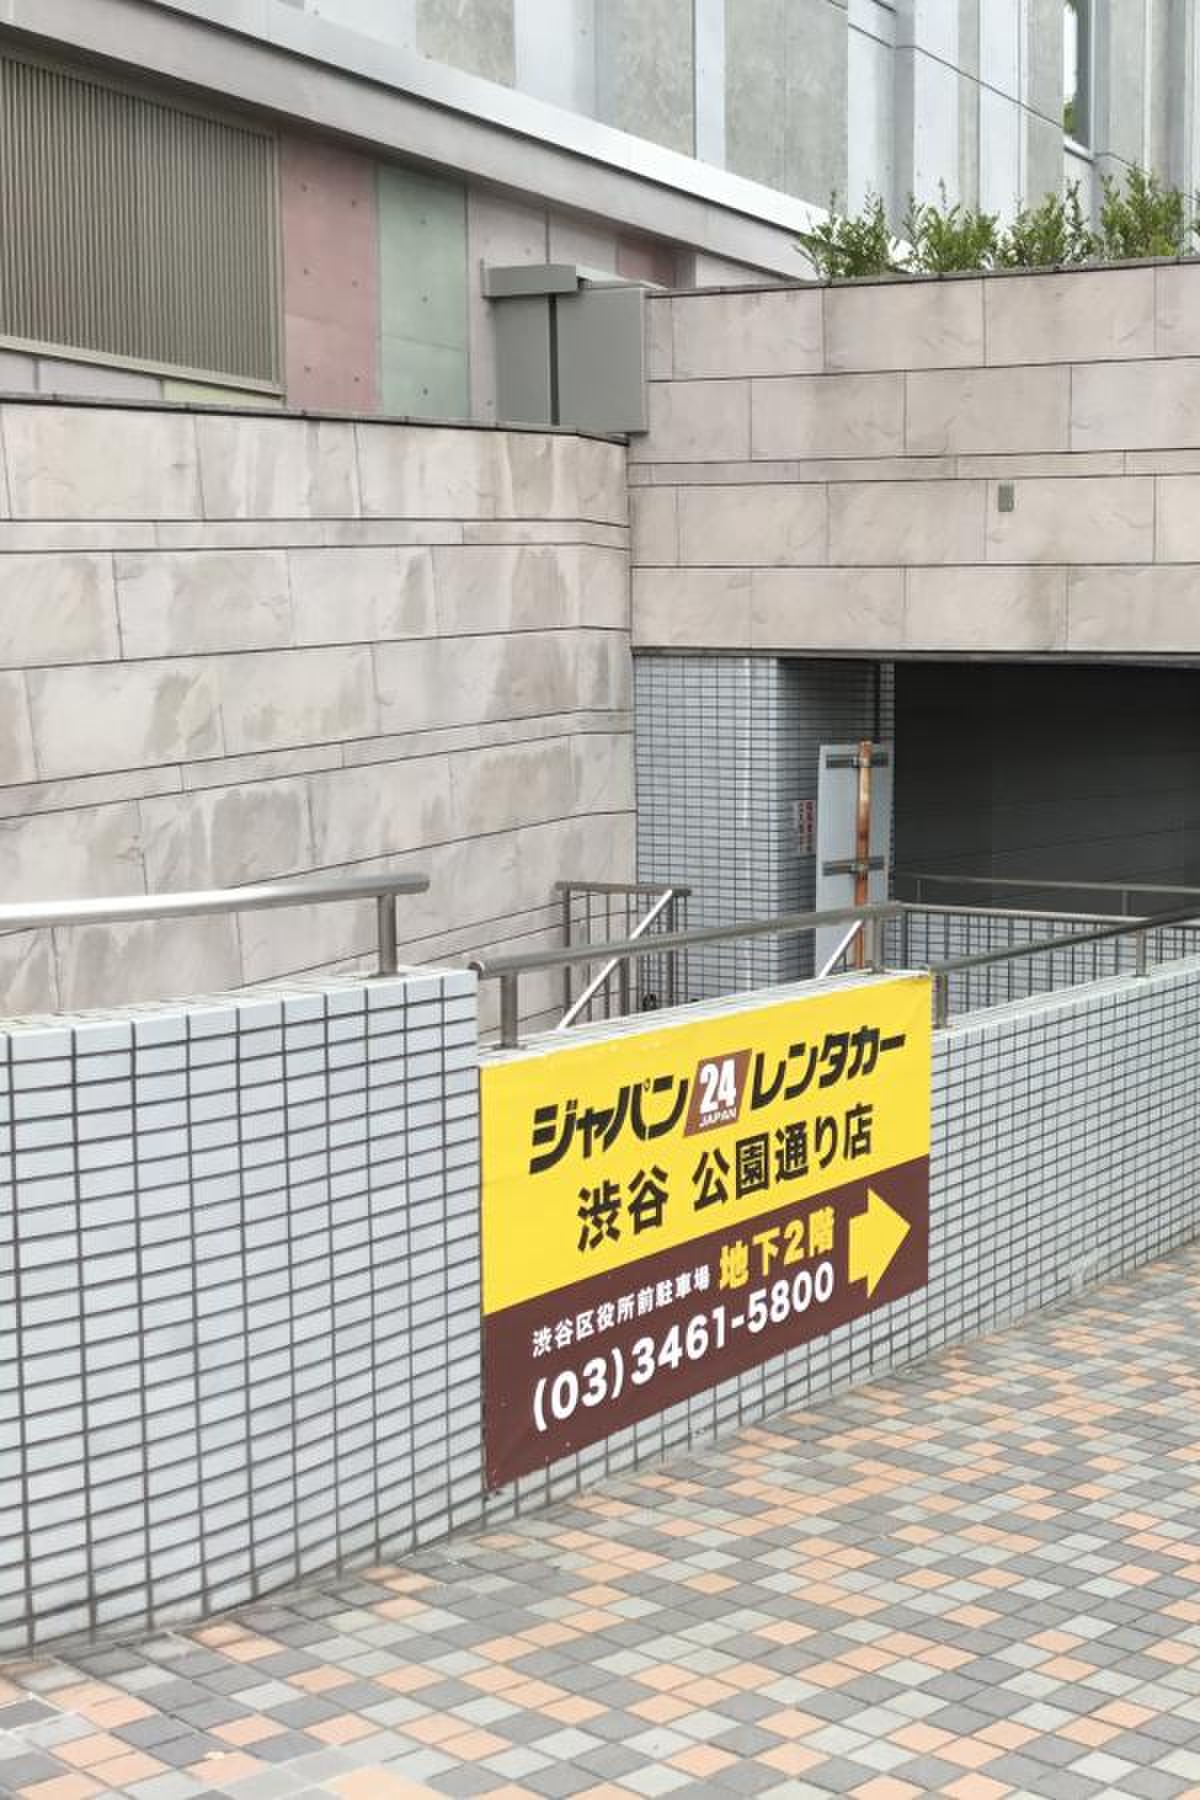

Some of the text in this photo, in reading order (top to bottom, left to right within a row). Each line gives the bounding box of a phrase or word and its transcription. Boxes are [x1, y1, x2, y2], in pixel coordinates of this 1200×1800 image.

[529, 1024, 906, 1175] ジャパン 24 レンタカー
[699, 1108, 739, 1128] JAPAN
[576, 1102, 874, 1252] 渋谷 公園通り店
[531, 1206, 836, 1359] 渋谷区役所前駐車場 地下2階
